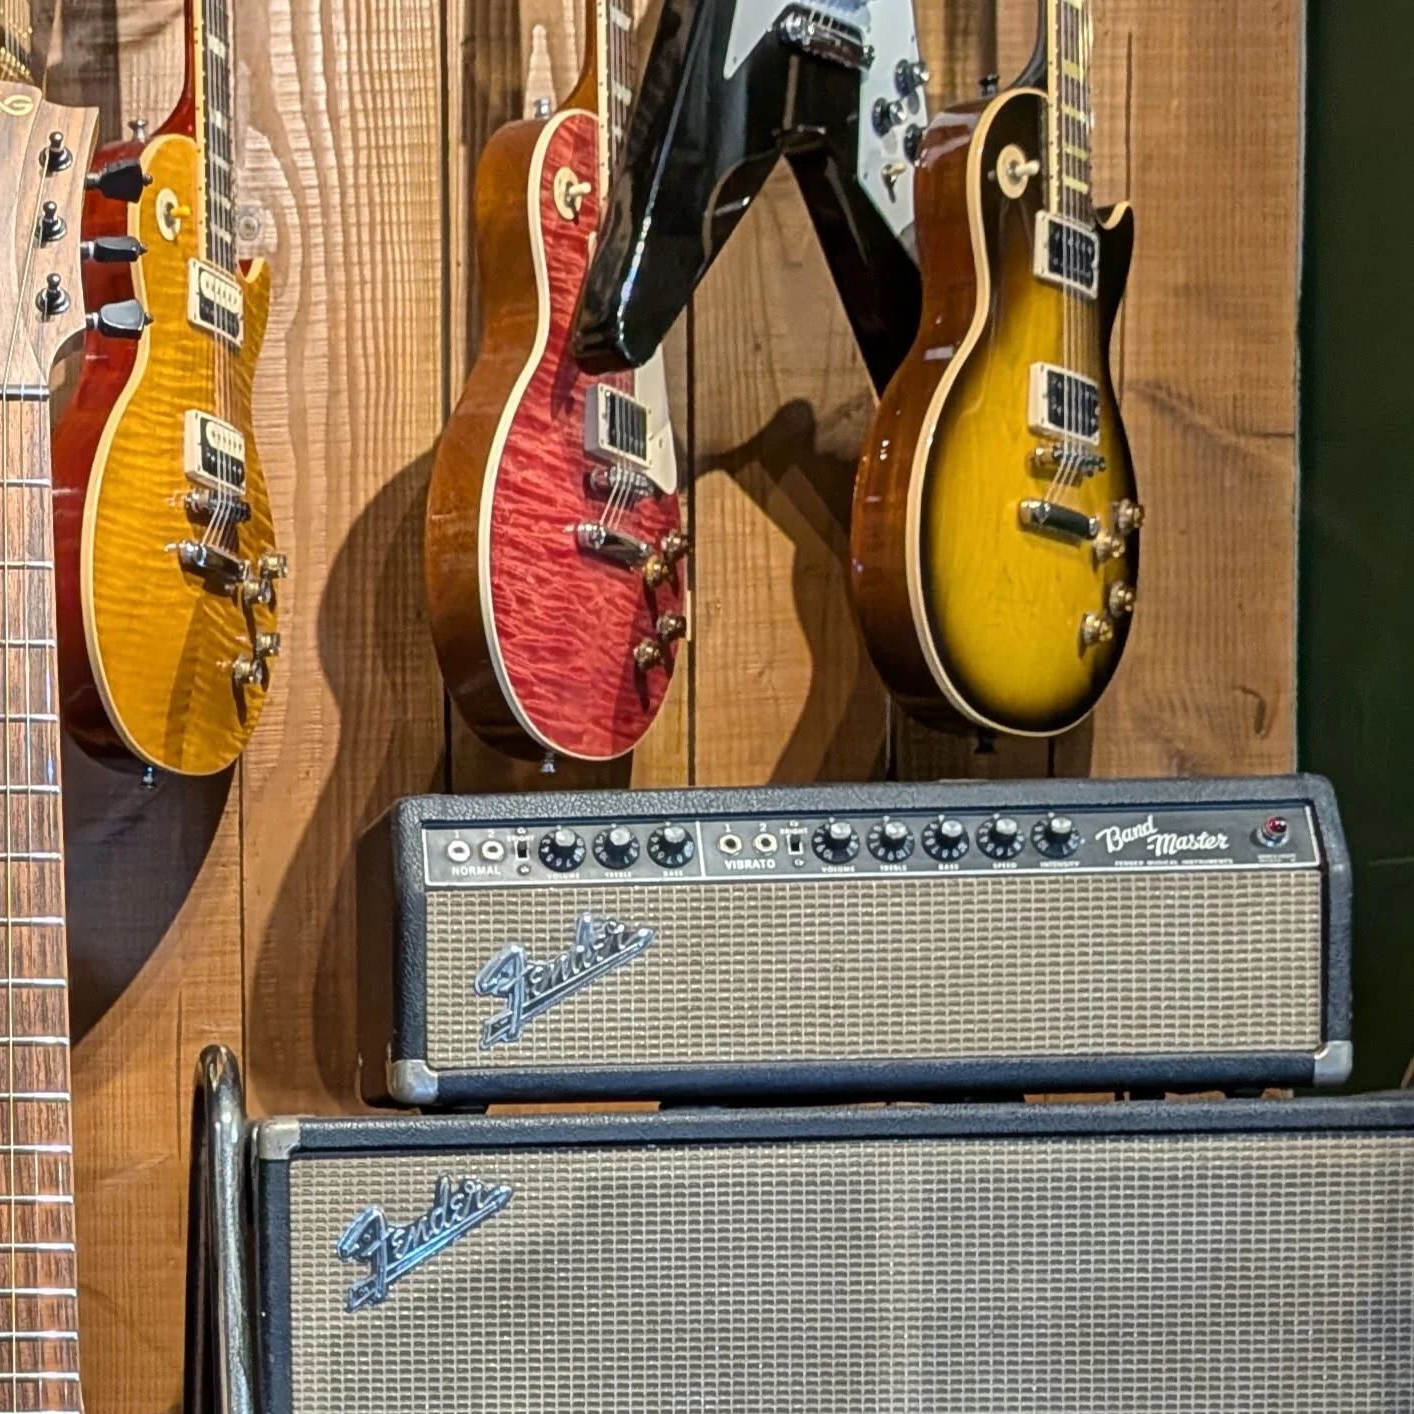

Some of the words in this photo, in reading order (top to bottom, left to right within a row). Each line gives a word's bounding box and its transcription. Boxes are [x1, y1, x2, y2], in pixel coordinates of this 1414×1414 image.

[487, 829, 495, 839] 2
[759, 822, 767, 832] 2
[1094, 813, 1159, 854] Band
[1146, 831, 1230, 857] Master
[451, 866, 502, 876] NORMAL
[724, 859, 776, 870] VIBRATO
[474, 911, 656, 1050] Fender
[337, 1172, 514, 1314] Fender
